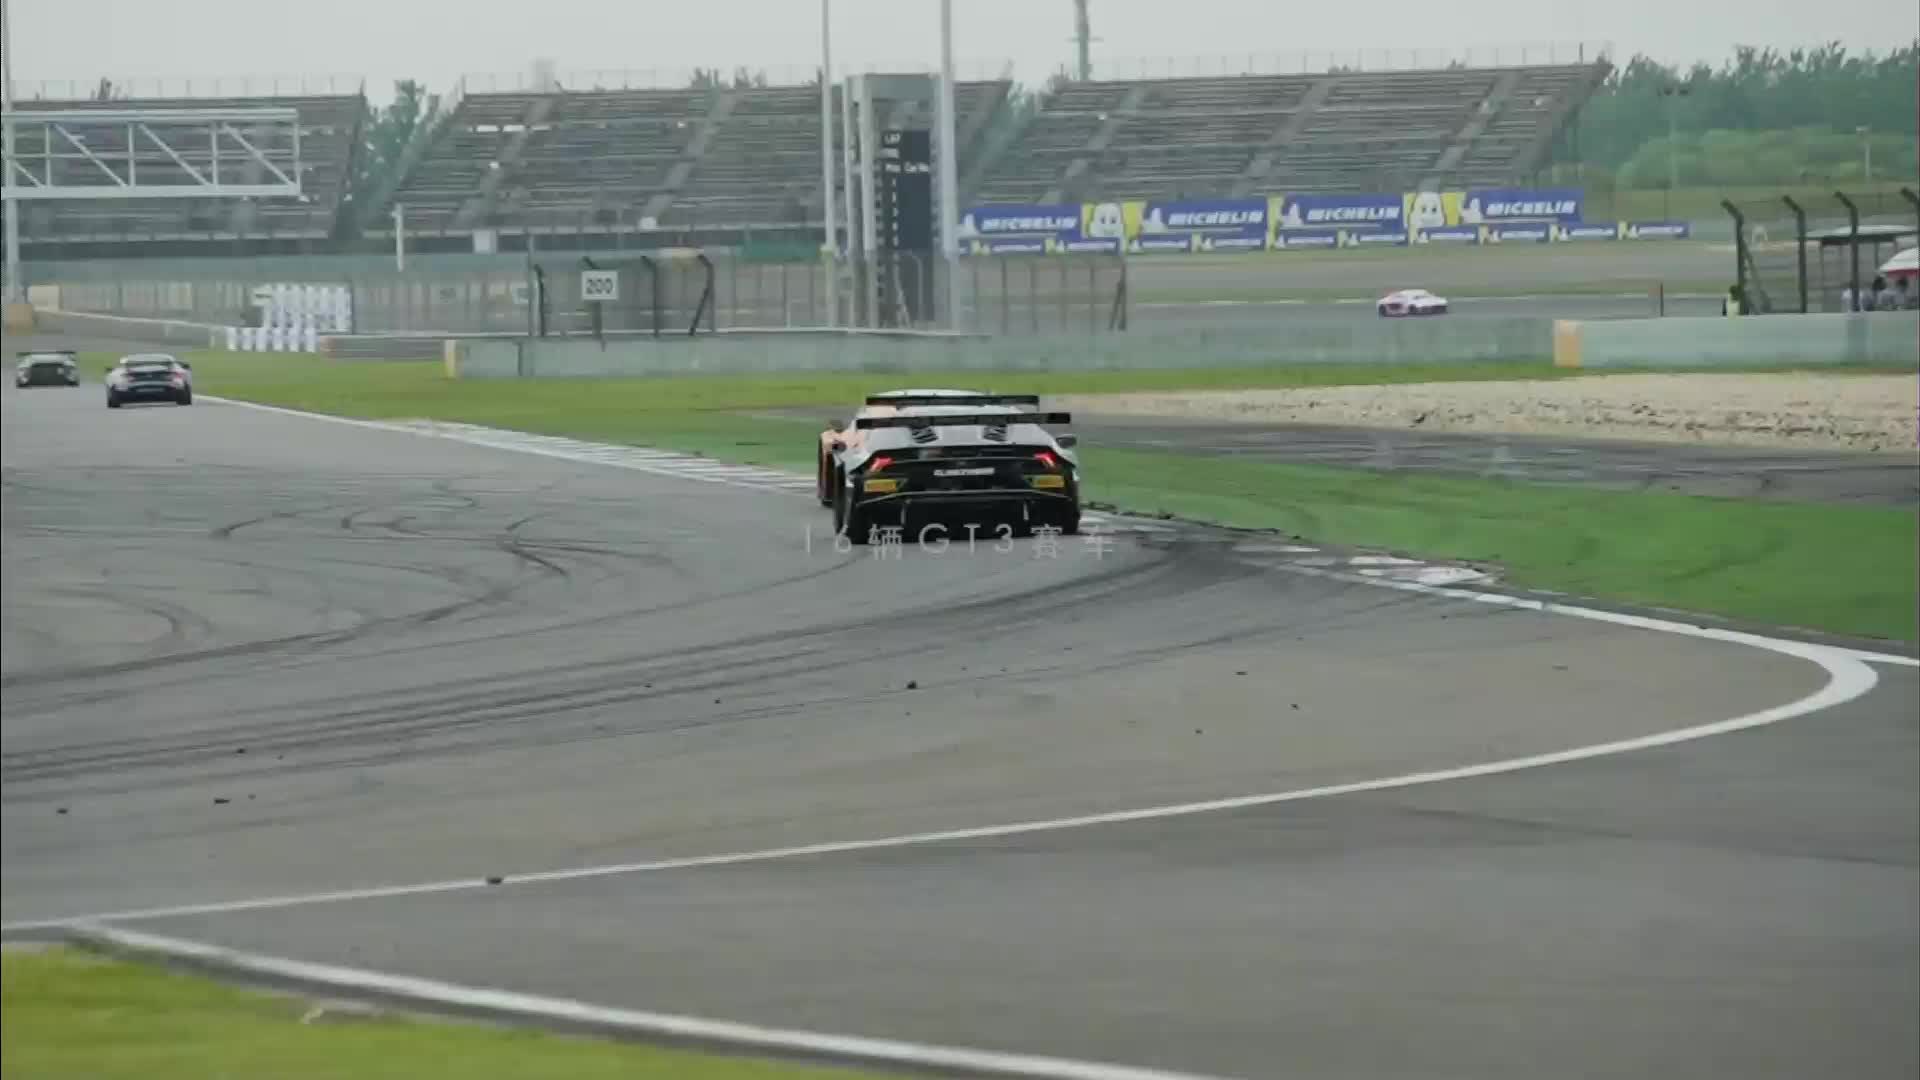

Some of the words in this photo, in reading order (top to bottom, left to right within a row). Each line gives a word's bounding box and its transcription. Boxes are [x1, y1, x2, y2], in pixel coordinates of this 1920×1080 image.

[1307, 207, 1400, 221] MICHELIN
[1486, 200, 1576, 216] MICHELIN
[981, 216, 1078, 231] MICHELIN
[1168, 210, 1264, 225] MICHELIN
[585, 278, 614, 295] 200
